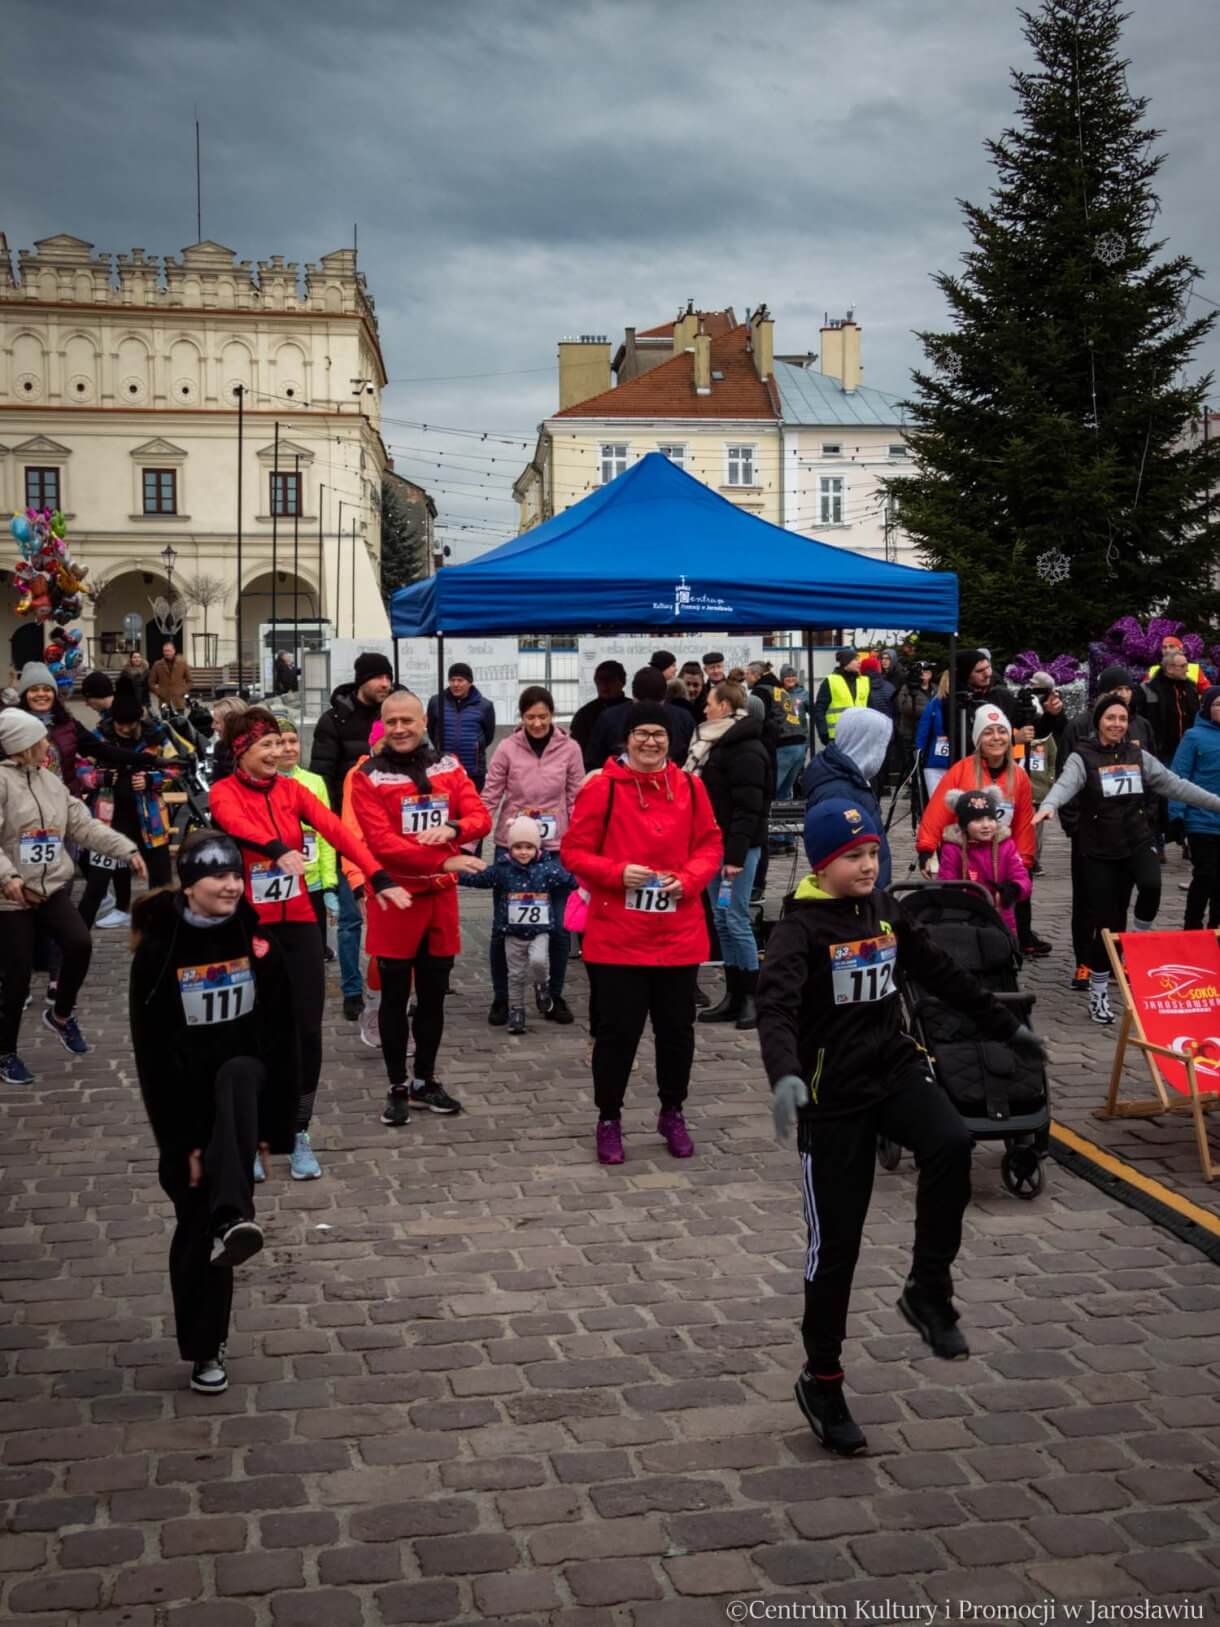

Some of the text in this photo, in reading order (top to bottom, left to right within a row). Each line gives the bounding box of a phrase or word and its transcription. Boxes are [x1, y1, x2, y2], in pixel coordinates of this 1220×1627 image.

[1032, 760, 1040, 770] 5
[1115, 777, 1132, 793] 71
[411, 809, 442, 832] 119
[30, 844, 55, 862] 35
[264, 875, 294, 900] 47
[635, 888, 670, 911] 118
[517, 906, 541, 923] 78
[850, 963, 891, 1001] 112
[202, 985, 243, 1022] 111
